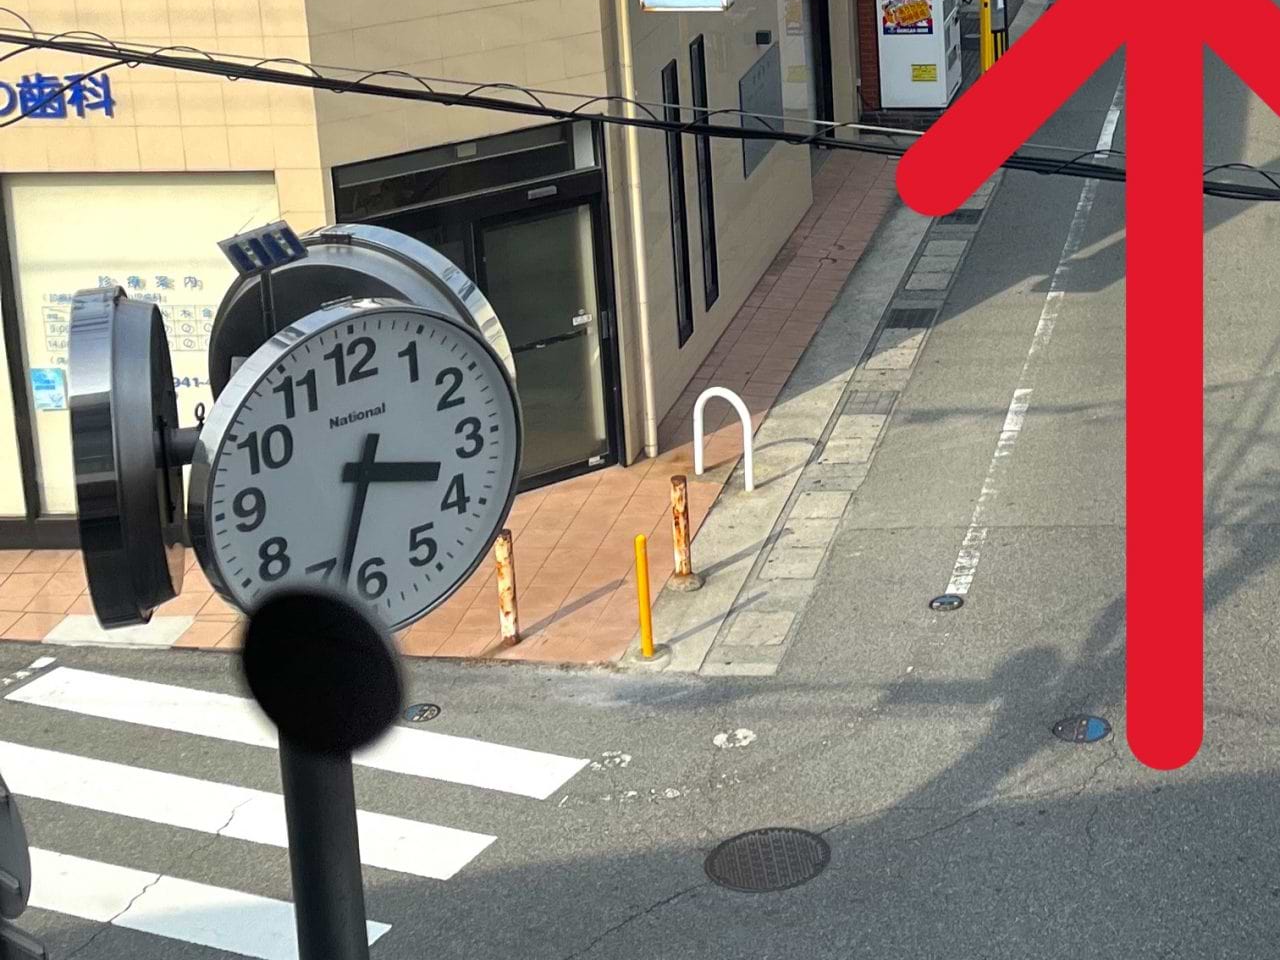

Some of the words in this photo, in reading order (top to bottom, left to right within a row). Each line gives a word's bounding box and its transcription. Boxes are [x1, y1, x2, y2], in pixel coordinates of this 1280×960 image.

[323, 337, 379, 386] 12
[398, 340, 420, 383] 1
[273, 368, 318, 419] 11
[434, 367, 466, 412] 2
[329, 402, 386, 429] National
[454, 416, 484, 459] 3
[237, 424, 293, 475] 10
[232, 487, 266, 532] 9
[440, 473, 470, 515] 4
[258, 536, 291, 582] 8
[408, 522, 438, 567] 5
[356, 557, 388, 600] 6
